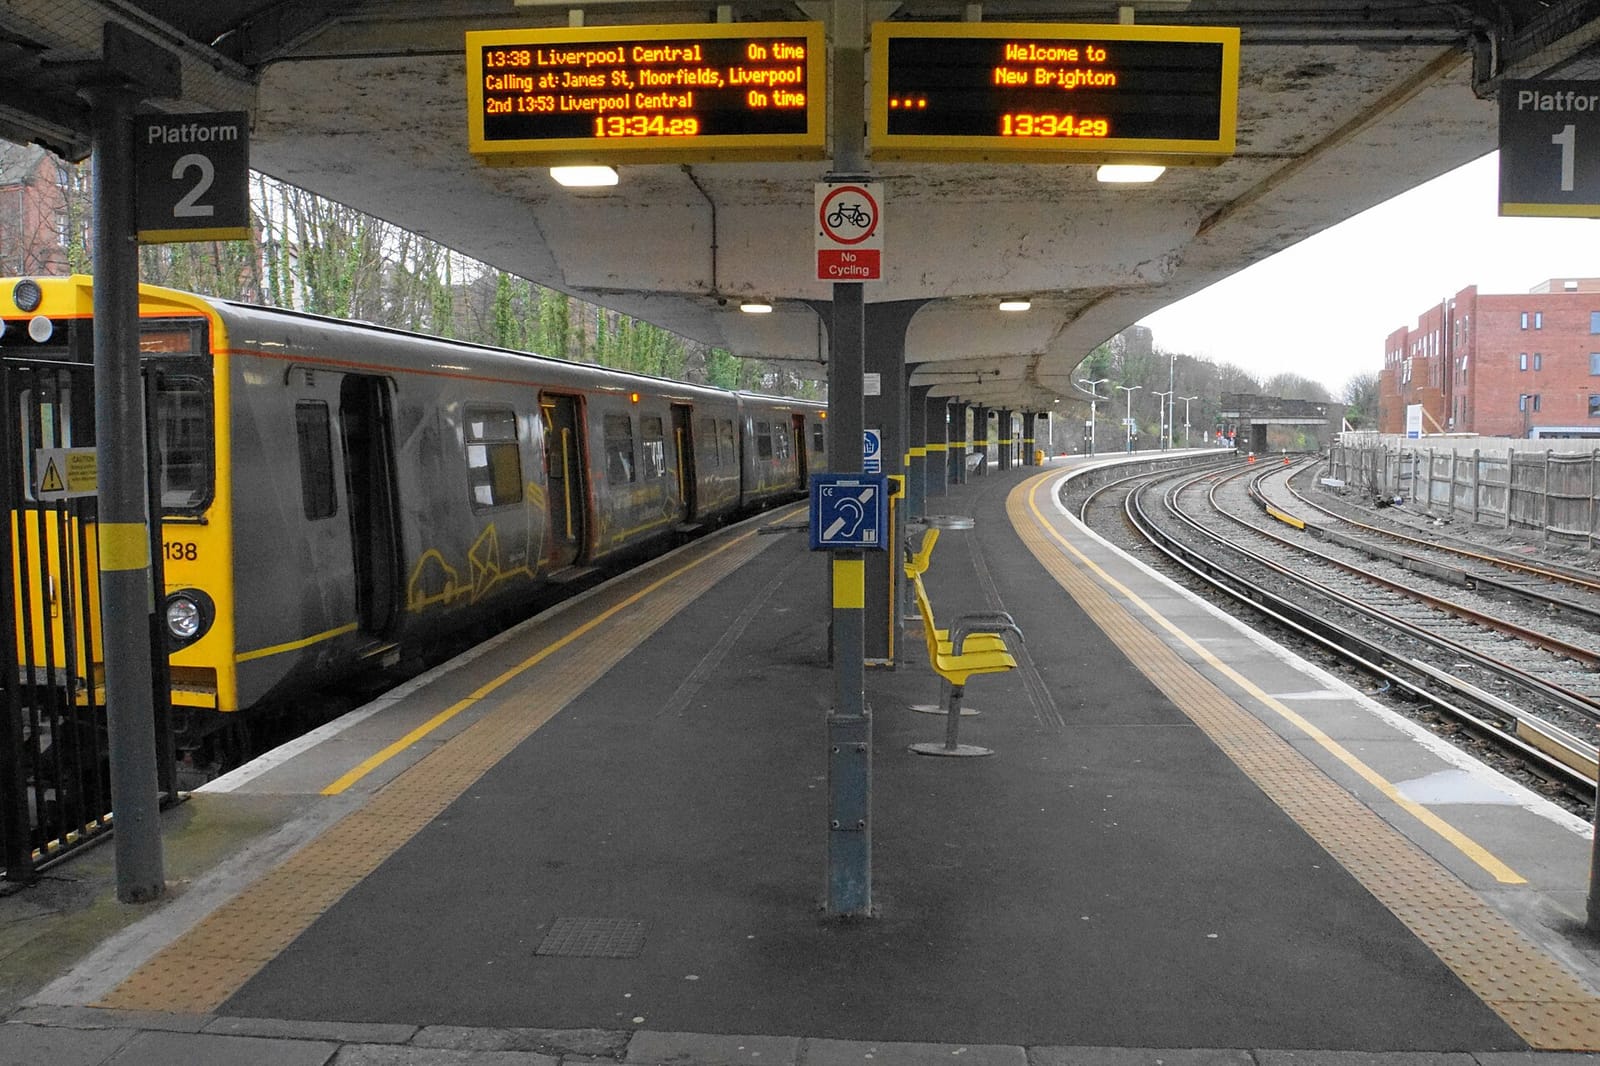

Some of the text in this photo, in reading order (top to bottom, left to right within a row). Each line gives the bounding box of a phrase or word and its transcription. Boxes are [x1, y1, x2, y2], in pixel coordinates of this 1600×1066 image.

[487, 43, 805, 68] 13:38 Liverpool Central On time
[1006, 43, 1106, 62] Welcome to
[486, 74, 533, 93] Calling
[611, 70, 635, 89] St,
[640, 68, 725, 88] Moorfields,
[729, 66, 802, 87] Liverpool
[995, 67, 1116, 89] New Brighton
[486, 90, 805, 113] 2nd 13:53 Liverpool Central On time
[1518, 90, 1600, 112] Platfor
[148, 123, 238, 144] Platform
[594, 115, 698, 137] 13:34.29
[1002, 114, 1108, 136] 13:34.29
[1551, 124, 1576, 191] 1
[171, 153, 215, 217] 2
[841, 252, 857, 262] No
[828, 264, 870, 276] Cycling
[822, 487, 833, 497] CE
[163, 541, 198, 561] 138
